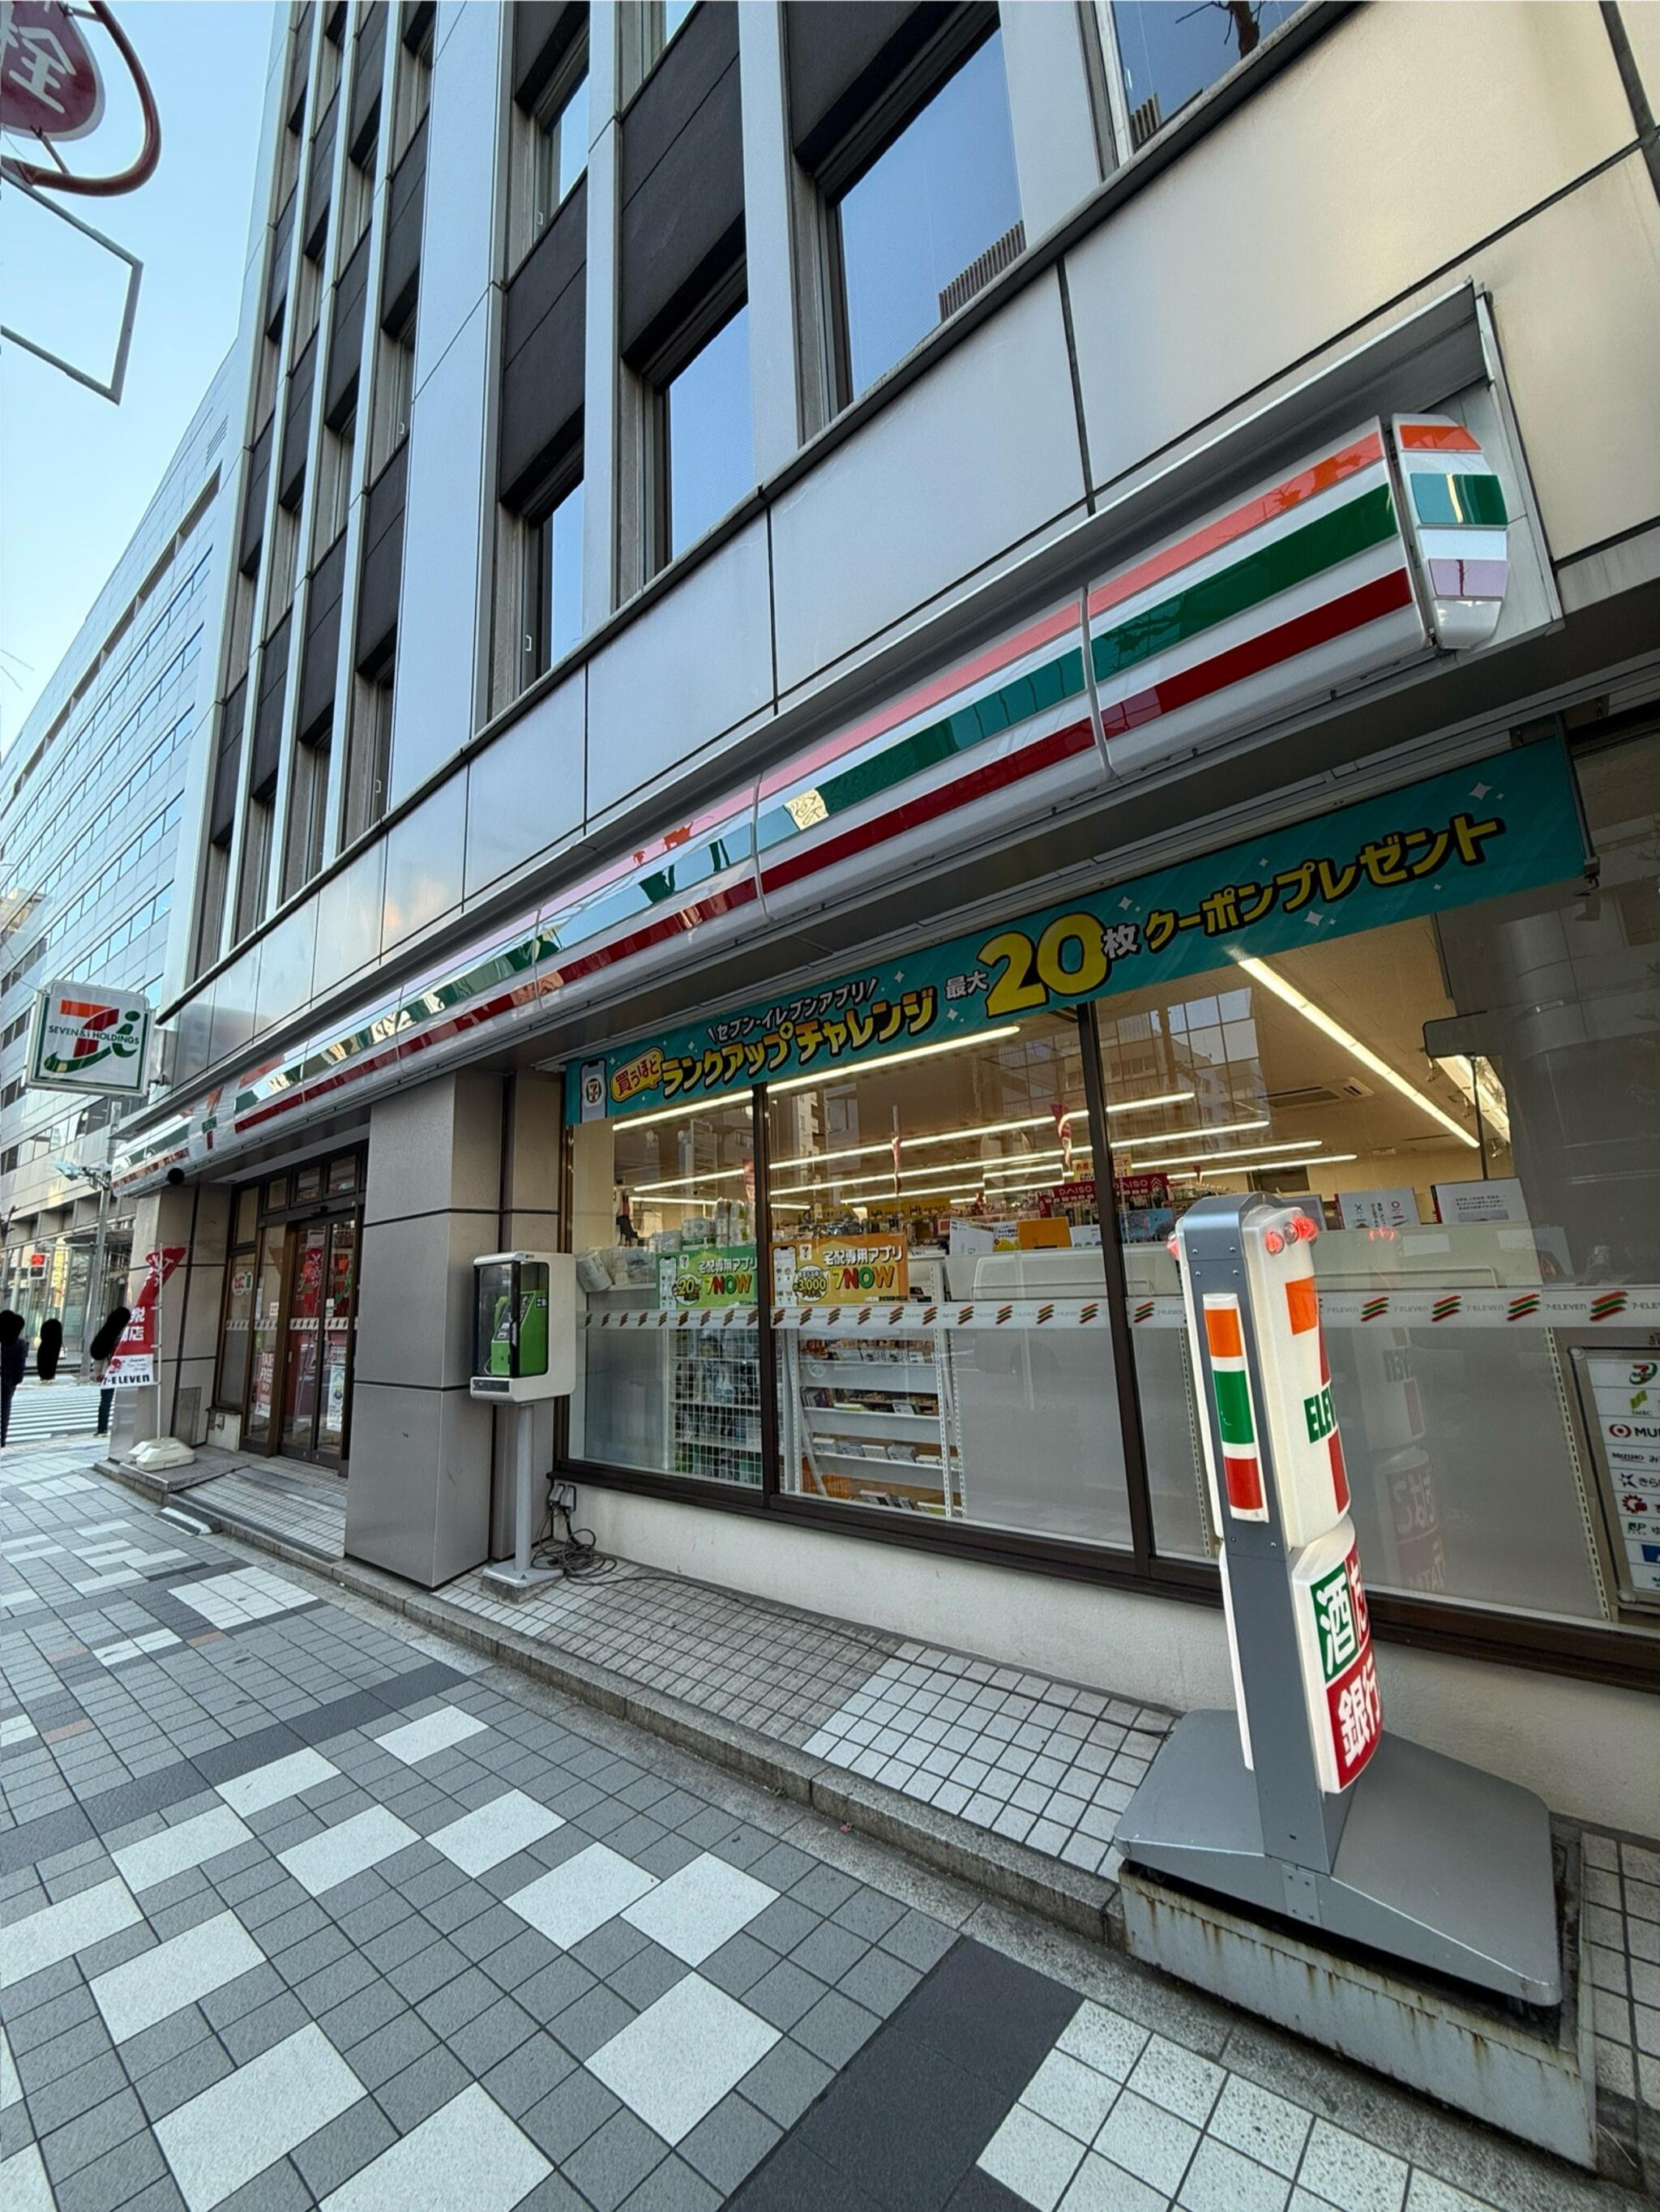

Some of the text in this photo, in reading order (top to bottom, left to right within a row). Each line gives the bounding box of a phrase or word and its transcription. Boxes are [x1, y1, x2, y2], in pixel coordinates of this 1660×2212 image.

[945, 815, 1503, 1017] 最大 20 枚 クーポンプレゼント
[92, 1032, 140, 1045] HOLDINGS
[616, 1055, 659, 1097] 買うほど
[1059, 1185, 1093, 1196] DAISO
[823, 1245, 902, 1266] 宅配専用アプリ
[831, 1265, 895, 1290] 7NOW
[1639, 1477, 1660, 1487] きら
[1316, 1571, 1356, 1676] 酒
